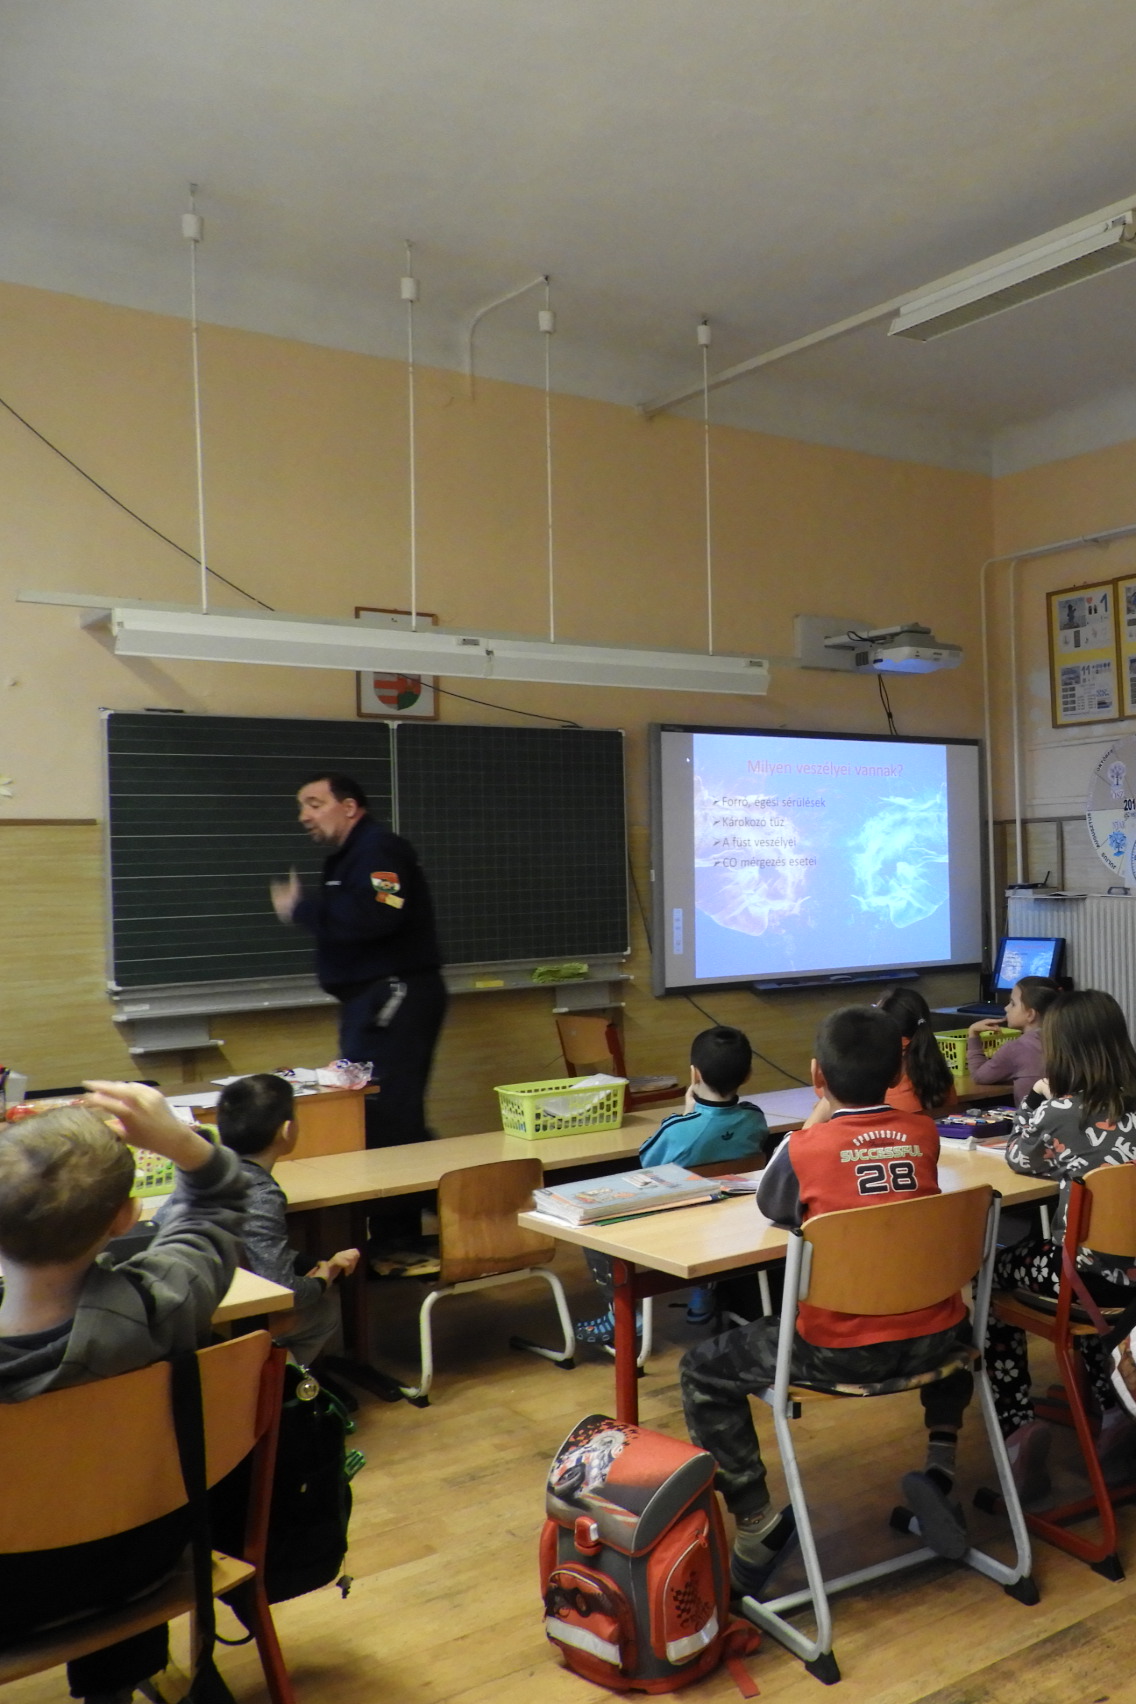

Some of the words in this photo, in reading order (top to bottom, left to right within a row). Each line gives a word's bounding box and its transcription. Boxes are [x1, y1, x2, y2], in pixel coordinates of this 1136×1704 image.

[1100, 593, 1108, 612] 1
[1081, 664, 1091, 677] 11
[747, 760, 792, 776] Milyen
[796, 761, 851, 778] veszélyei
[854, 764, 904, 777] vannak?
[722, 796, 751, 808] Forró,
[722, 817, 767, 827] Károkozó
[722, 837, 730, 847] A
[732, 836, 751, 847] füst
[754, 836, 796, 849] veszélyei
[722, 857, 737, 867] CO
[740, 856, 786, 869] mérgezés
[789, 856, 817, 866] esetei
[840, 1145, 924, 1163] SUCCESSFUL
[855, 1160, 918, 1196] 28
